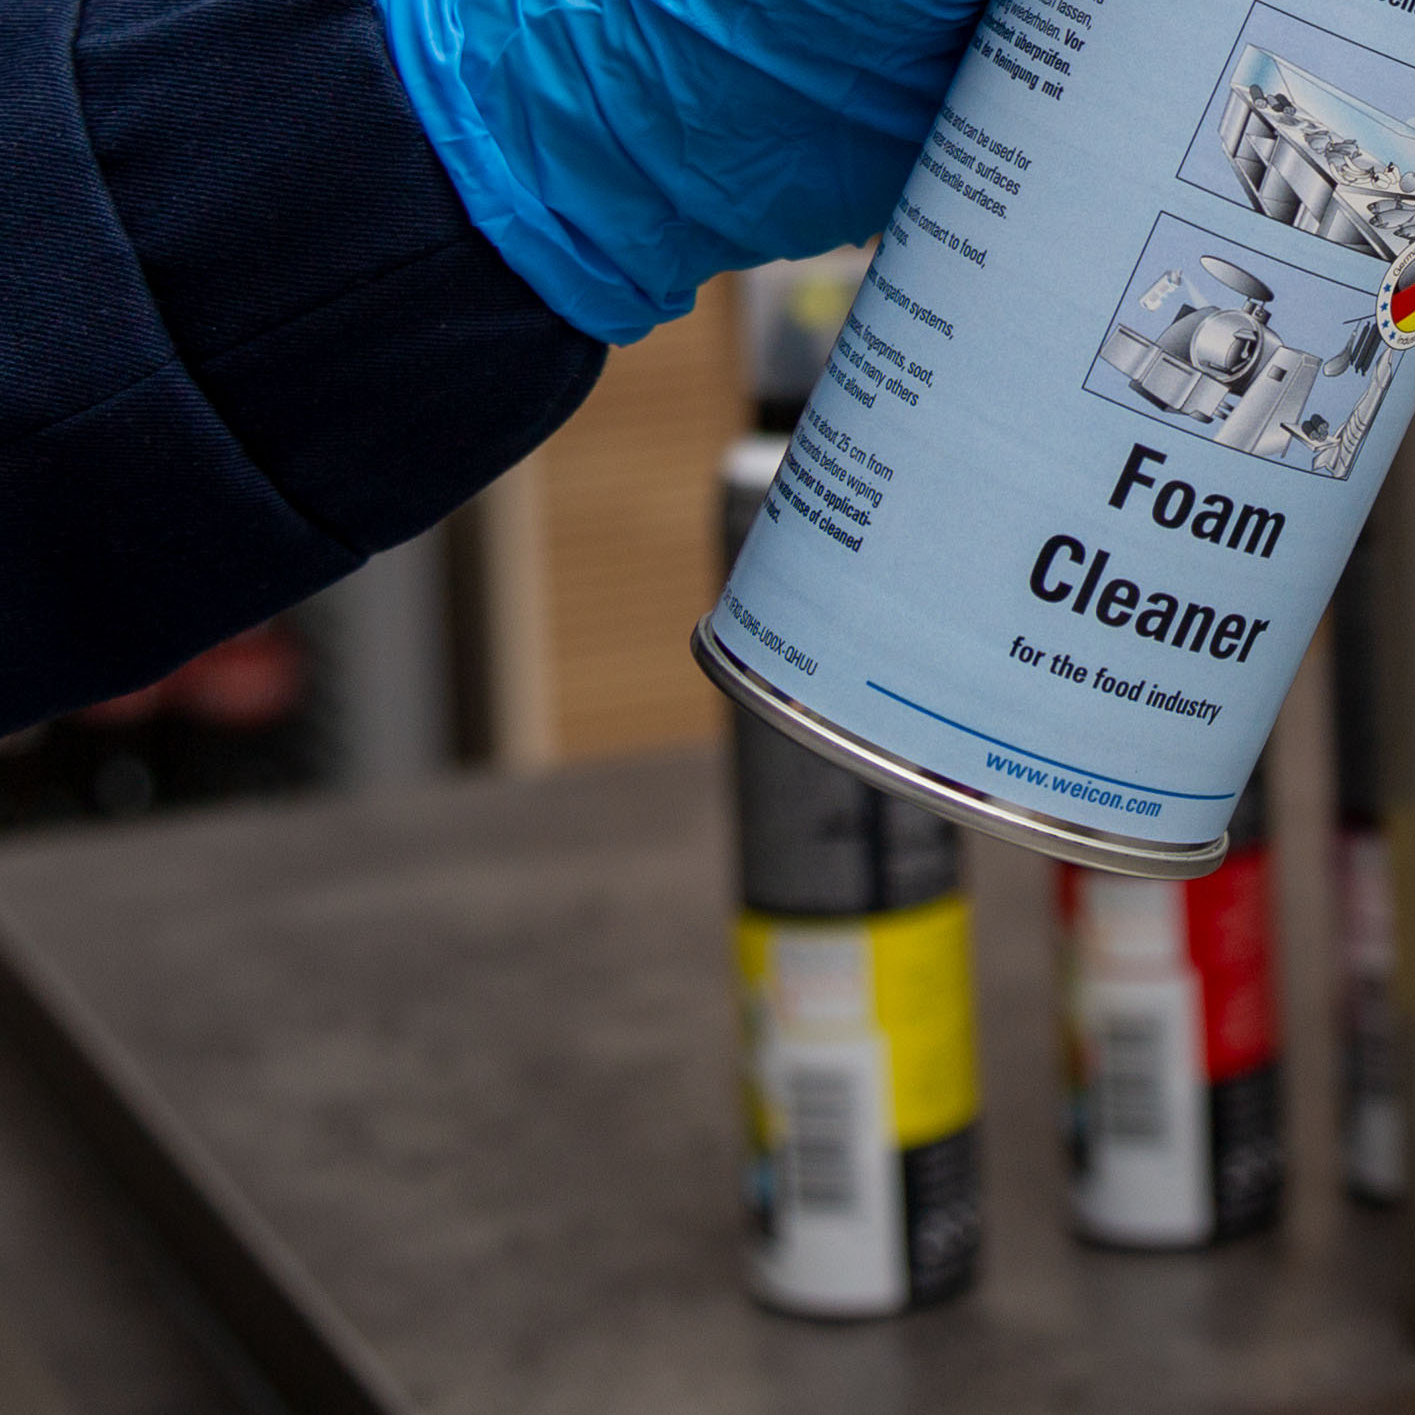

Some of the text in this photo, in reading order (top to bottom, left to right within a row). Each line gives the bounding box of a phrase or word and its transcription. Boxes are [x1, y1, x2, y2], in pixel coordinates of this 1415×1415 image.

[1014, 31, 1071, 76] überprüfen.
[1064, 29, 1085, 52] Vor
[993, 48, 1040, 90] Reinigung
[1041, 81, 1064, 101] mit
[976, 128, 990, 148] be
[988, 140, 1016, 162] used
[1014, 150, 1032, 171] for
[975, 162, 1021, 195] surfaces
[962, 184, 1006, 219] surfaces.
[918, 215, 949, 244] contact
[948, 233, 960, 250] to
[959, 239, 987, 269] food,
[909, 302, 953, 340] systems,
[861, 361, 886, 388] many
[885, 378, 919, 406] others
[907, 362, 933, 388] soot,
[836, 433, 851, 453] 25
[849, 446, 866, 464] cm
[866, 453, 893, 481] from
[814, 480, 825, 497] to
[823, 489, 871, 527] applicati-
[846, 474, 883, 508] wiping
[1108, 443, 1286, 559] Foam
[809, 509, 823, 525] of
[819, 517, 864, 553] cleaned
[1029, 534, 1270, 663] Cleaner
[1009, 636, 1222, 726] for the food industry
[985, 751, 1162, 818] www.weicon.com
